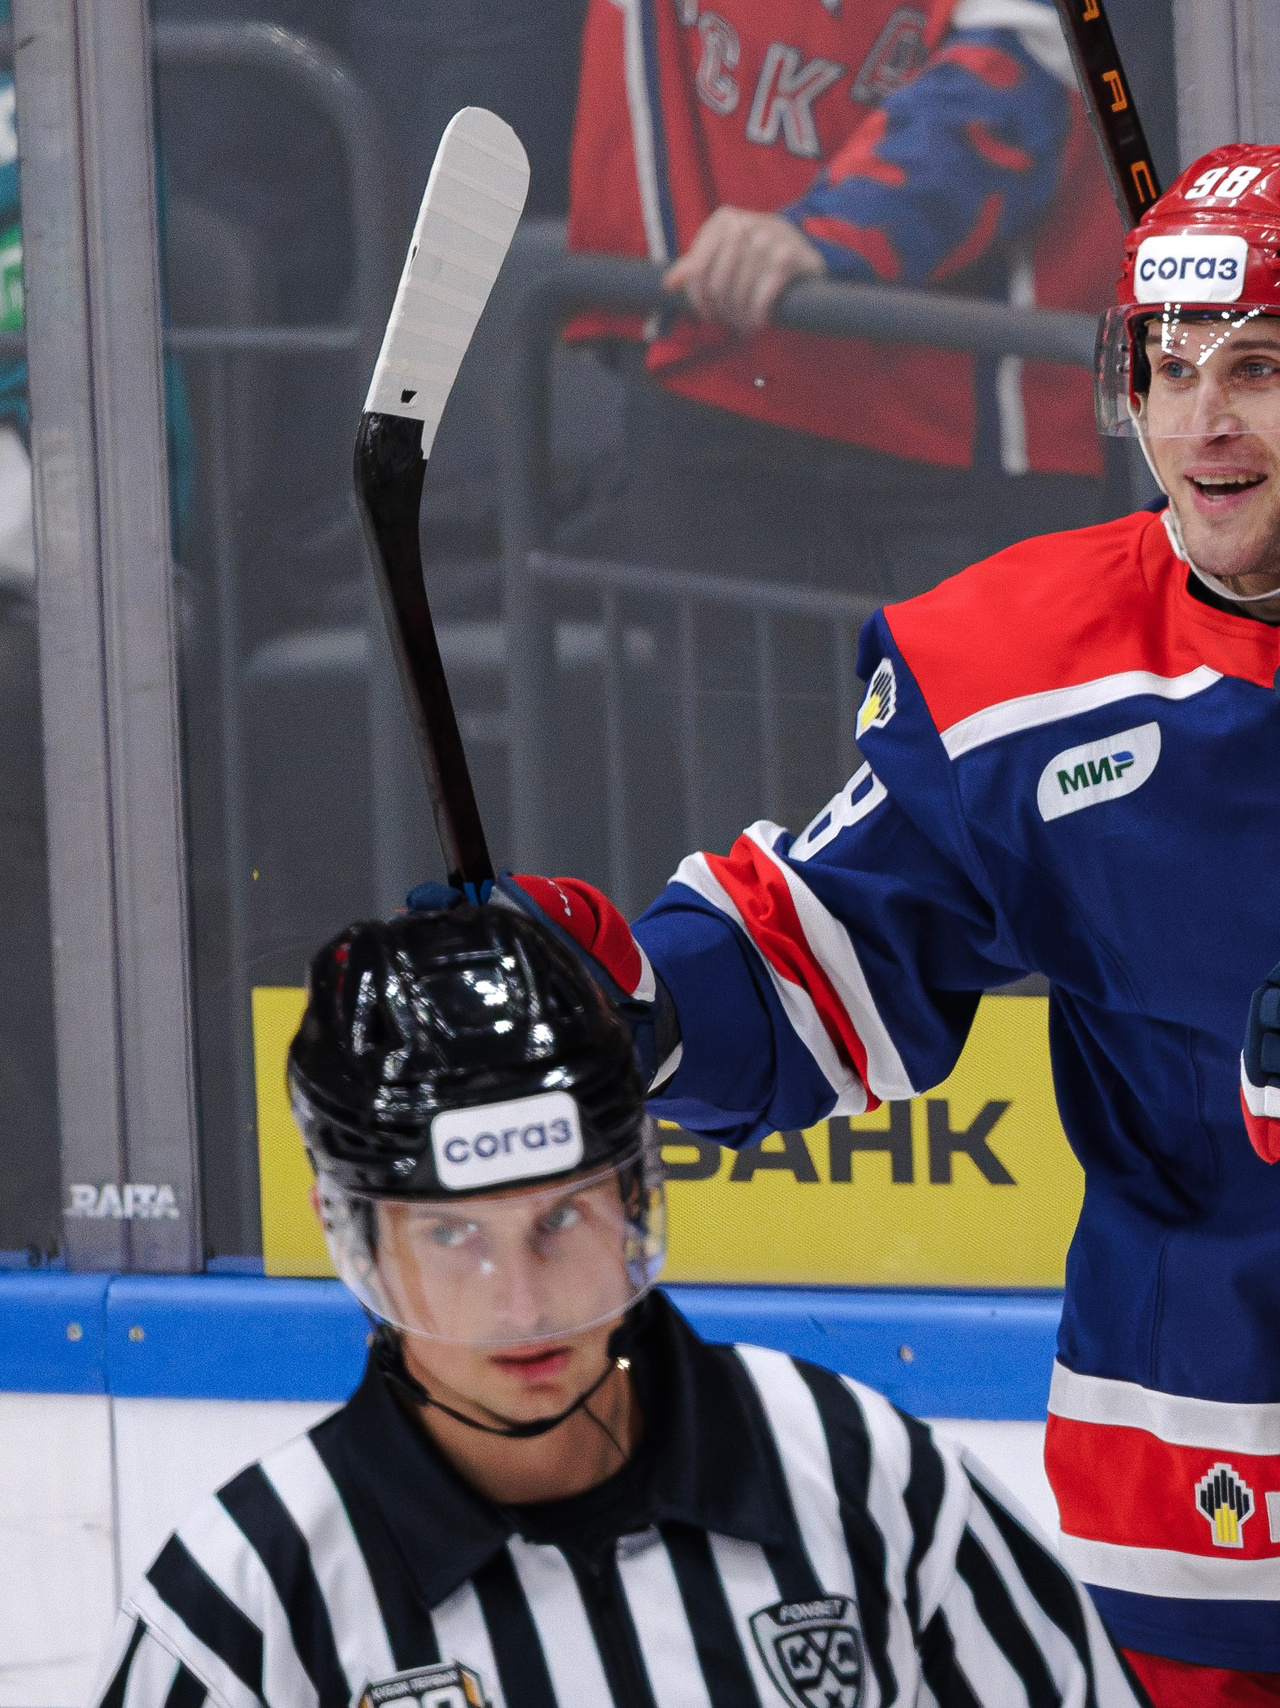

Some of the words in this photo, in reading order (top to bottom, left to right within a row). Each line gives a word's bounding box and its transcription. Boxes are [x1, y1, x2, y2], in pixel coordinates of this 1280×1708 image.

[1184, 165, 1262, 200] 98
[1139, 256, 1239, 282] согаз
[1056, 750, 1135, 795] МИР
[443, 1117, 574, 1166] согаз
